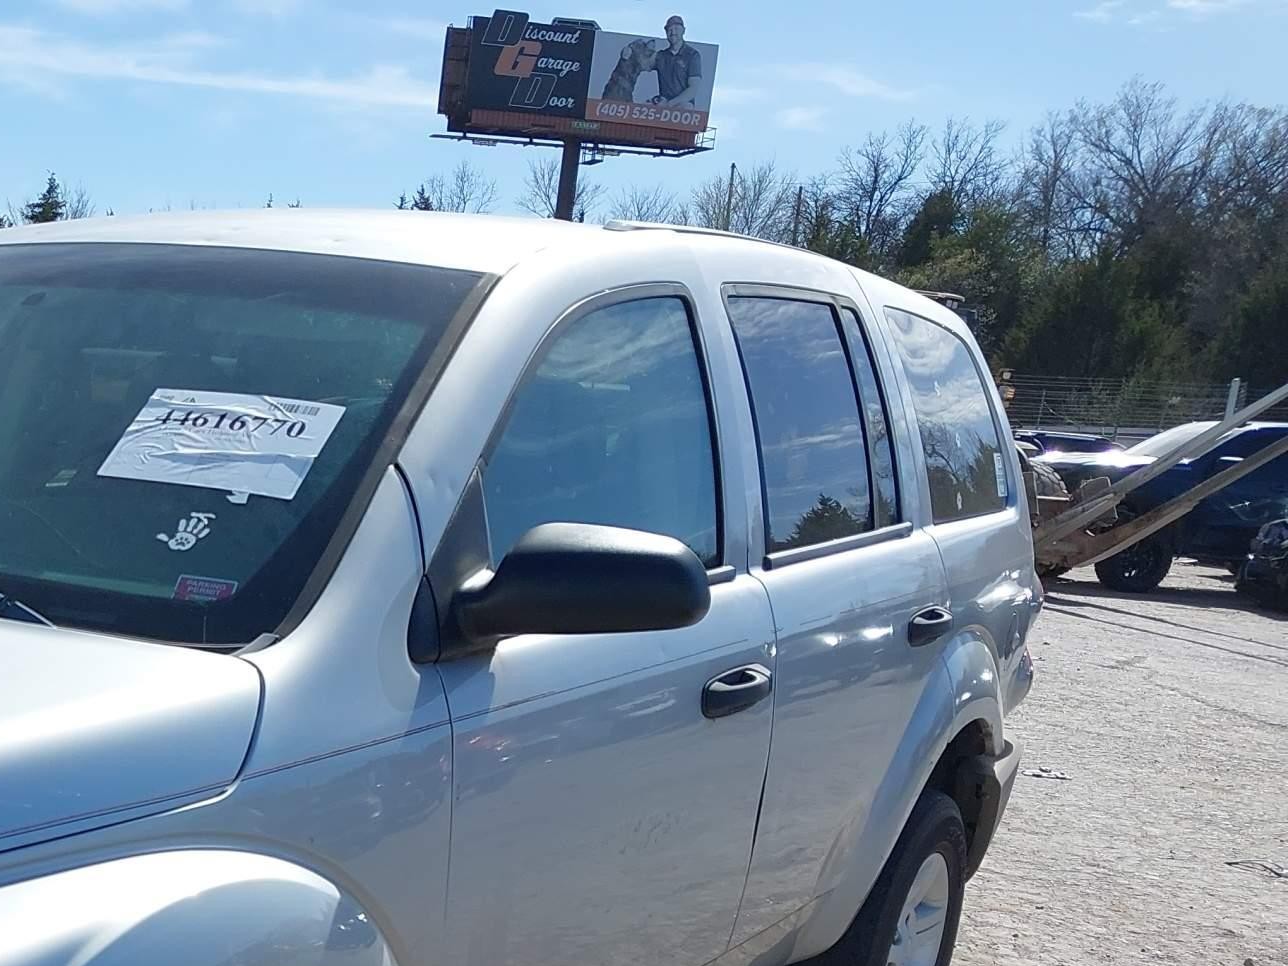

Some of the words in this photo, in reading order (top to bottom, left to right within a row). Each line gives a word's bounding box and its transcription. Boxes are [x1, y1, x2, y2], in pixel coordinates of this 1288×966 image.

[481, 9, 580, 47] Discount
[494, 42, 580, 78] Garage
[509, 72, 575, 110] Door
[596, 102, 630, 119] (405)
[631, 105, 701, 126] 525-DOOR
[155, 408, 306, 438] 44616770
